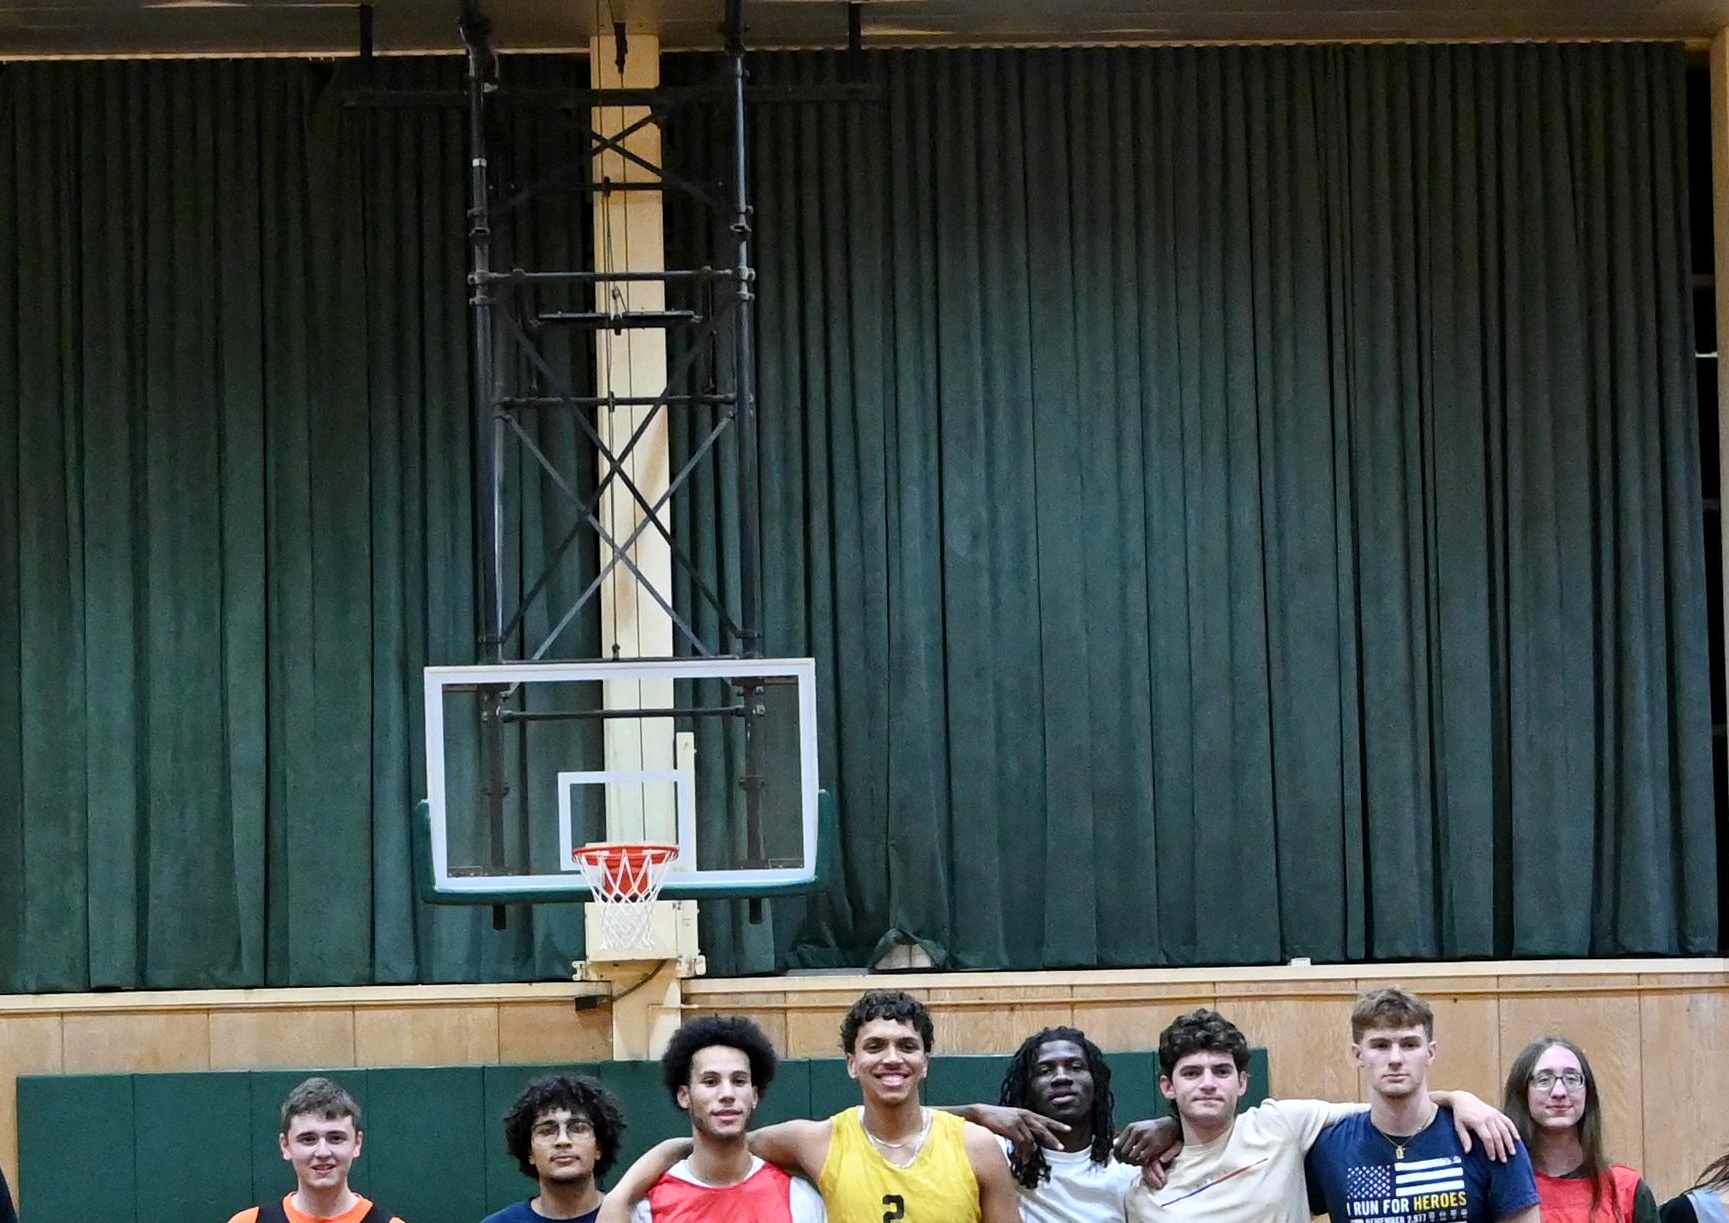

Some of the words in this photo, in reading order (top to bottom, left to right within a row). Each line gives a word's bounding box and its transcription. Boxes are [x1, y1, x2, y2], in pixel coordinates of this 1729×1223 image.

[1346, 1202, 1351, 1216] I
[1353, 1200, 1379, 1216] RUN
[1382, 1198, 1410, 1214] FOR
[1413, 1191, 1467, 1211] HEROES
